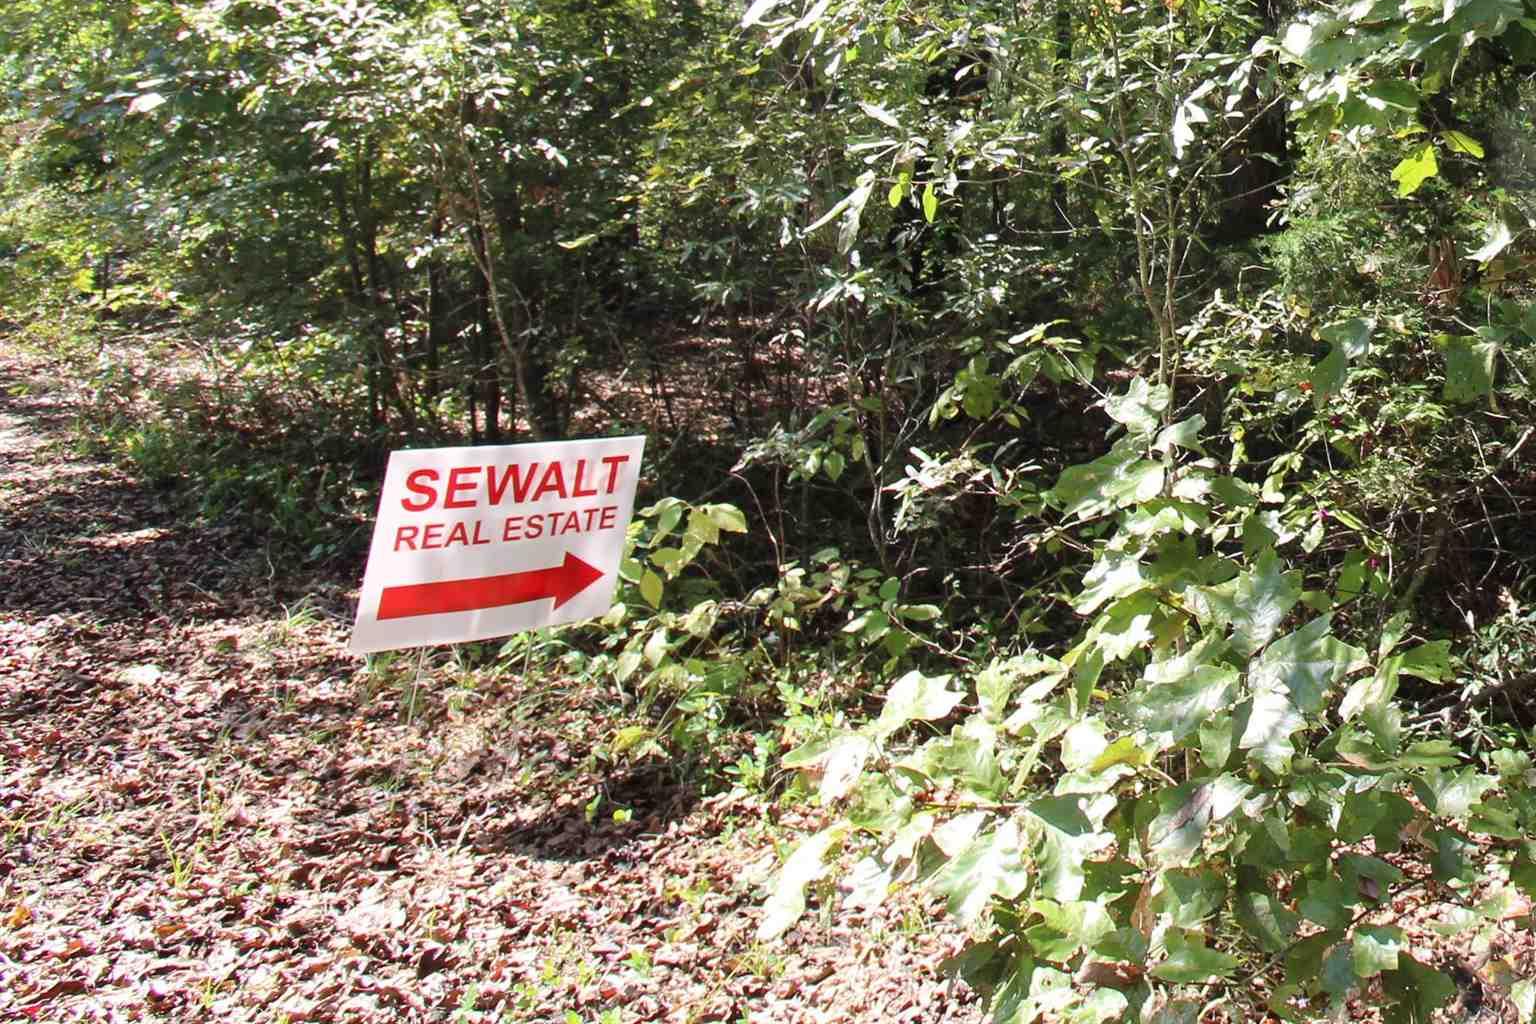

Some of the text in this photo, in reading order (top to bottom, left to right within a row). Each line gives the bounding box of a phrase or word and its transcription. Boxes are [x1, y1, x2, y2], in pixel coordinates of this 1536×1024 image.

[401, 455, 629, 512] SEWALT
[394, 506, 618, 551] REAL ESTATE
